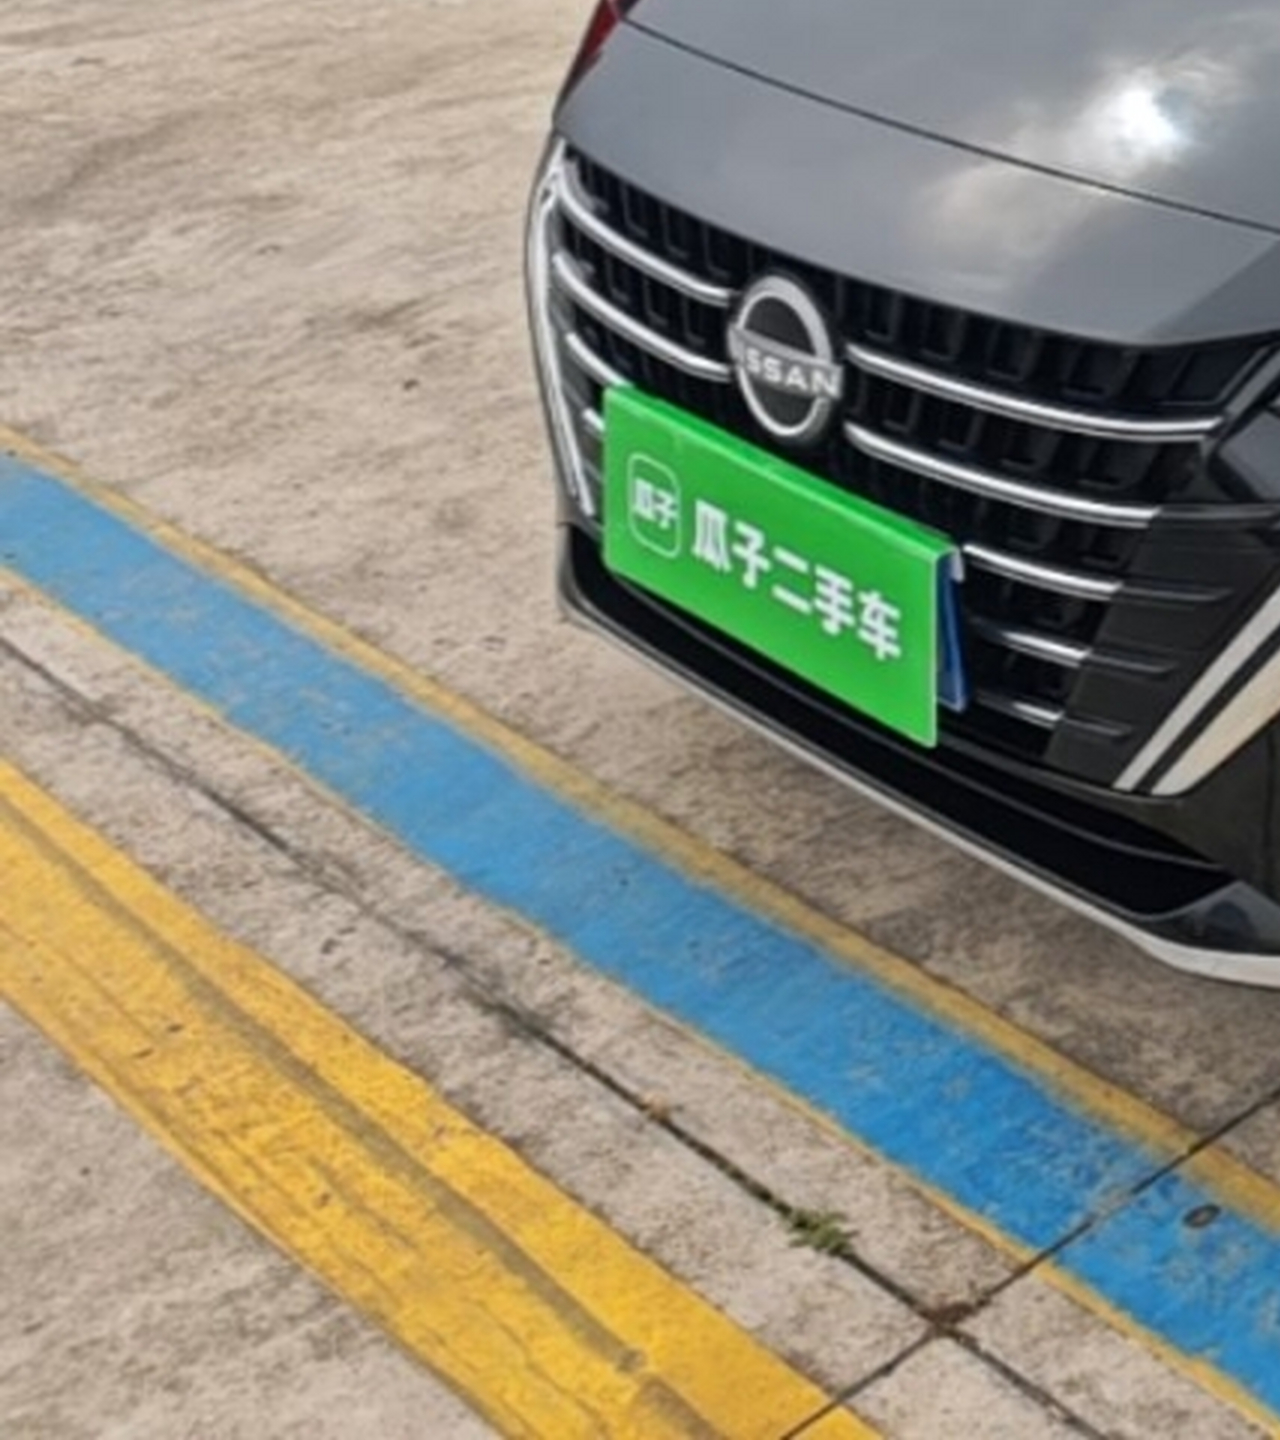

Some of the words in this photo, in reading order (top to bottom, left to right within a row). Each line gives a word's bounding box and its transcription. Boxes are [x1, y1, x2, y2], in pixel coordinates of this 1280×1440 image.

[731, 337, 842, 398] SSAN
[634, 477, 680, 529] 瓜子
[691, 497, 901, 661] 瓜子二手车
